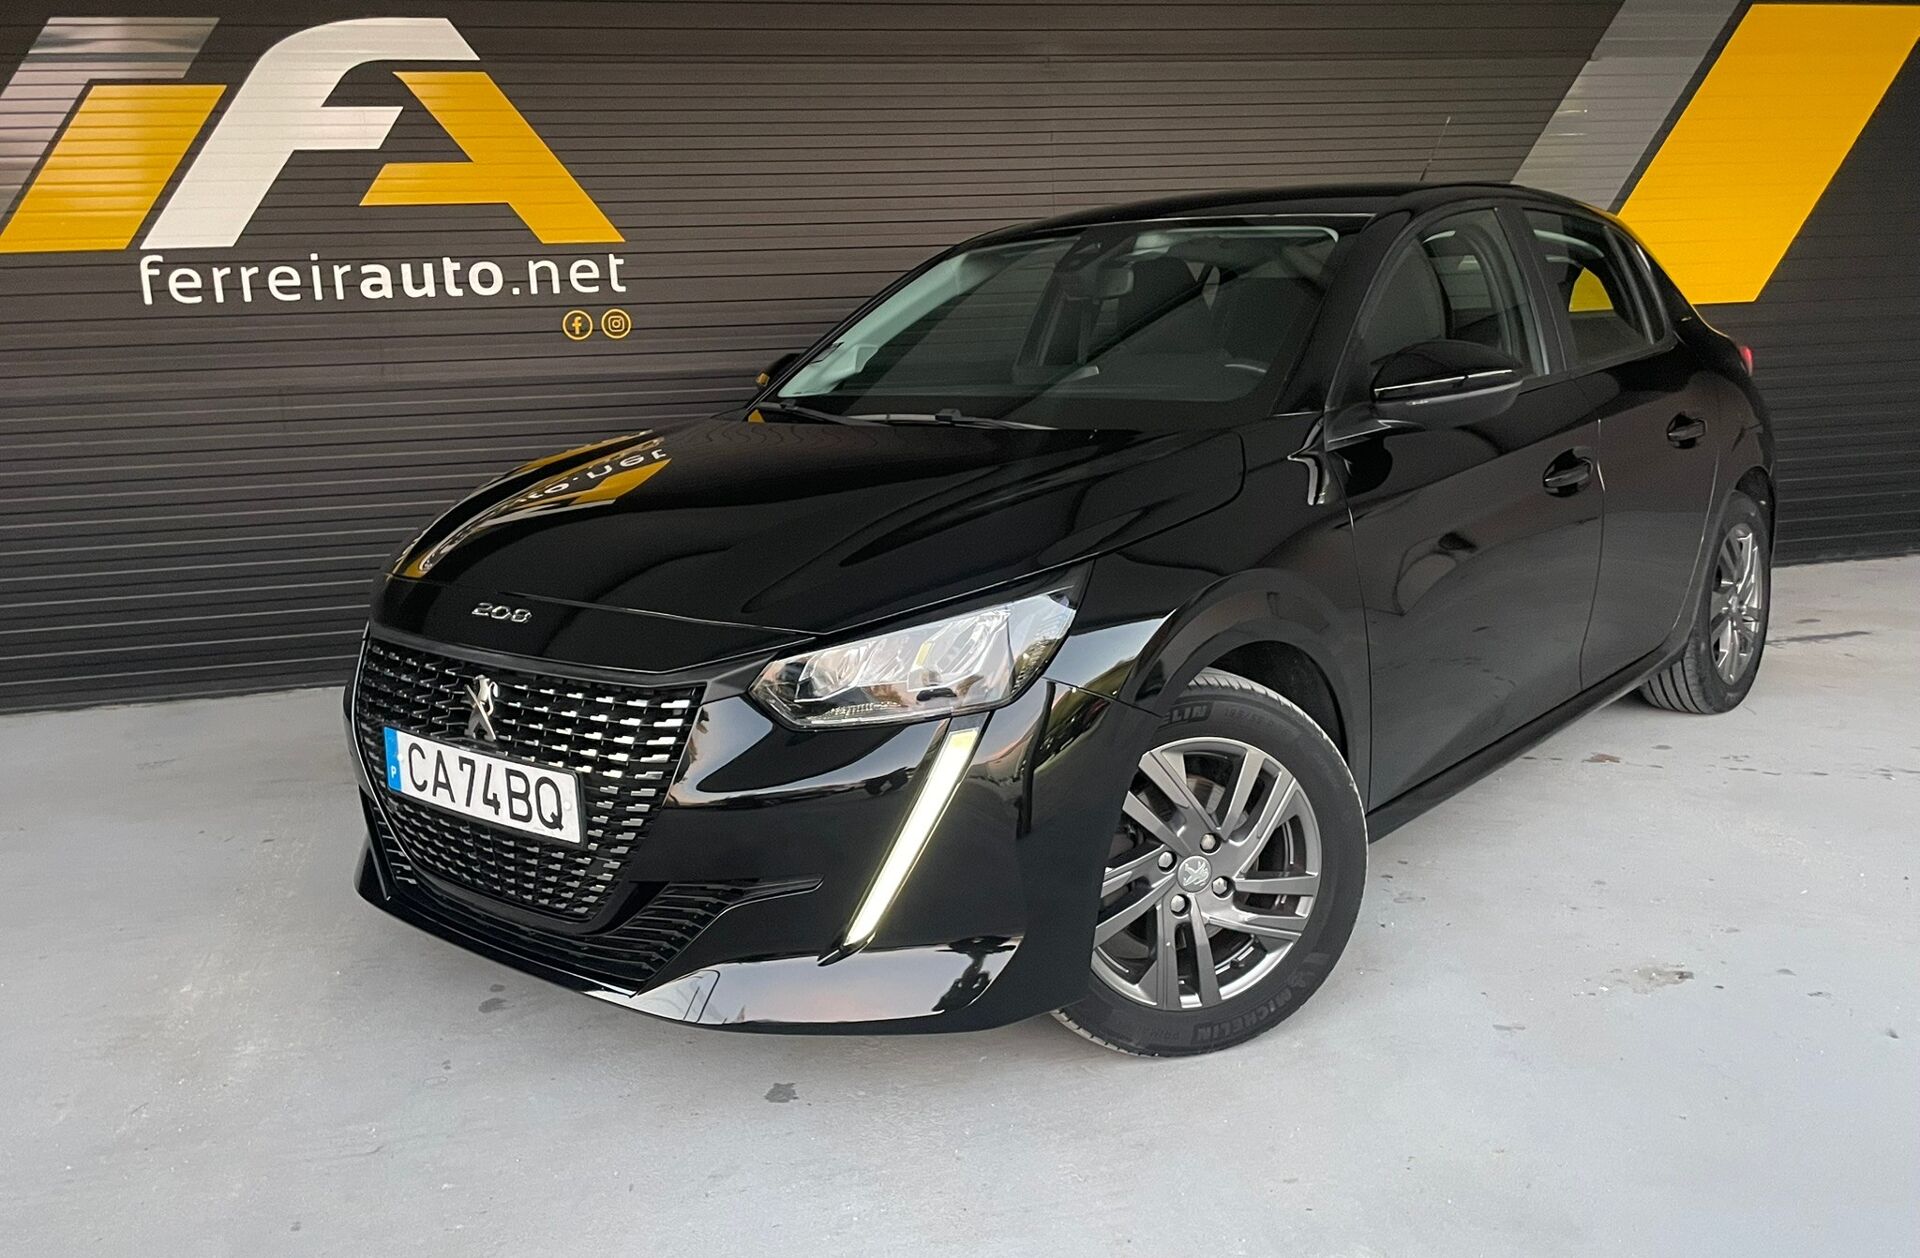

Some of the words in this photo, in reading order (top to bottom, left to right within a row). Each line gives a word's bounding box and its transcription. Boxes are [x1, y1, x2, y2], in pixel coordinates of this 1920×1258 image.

[140, 253, 627, 305] ferreirauto.net
[471, 602, 533, 624] 208
[390, 765, 397, 778] P
[408, 742, 564, 831] CA74BQ
[1198, 987, 1291, 1041] MICHELIN
